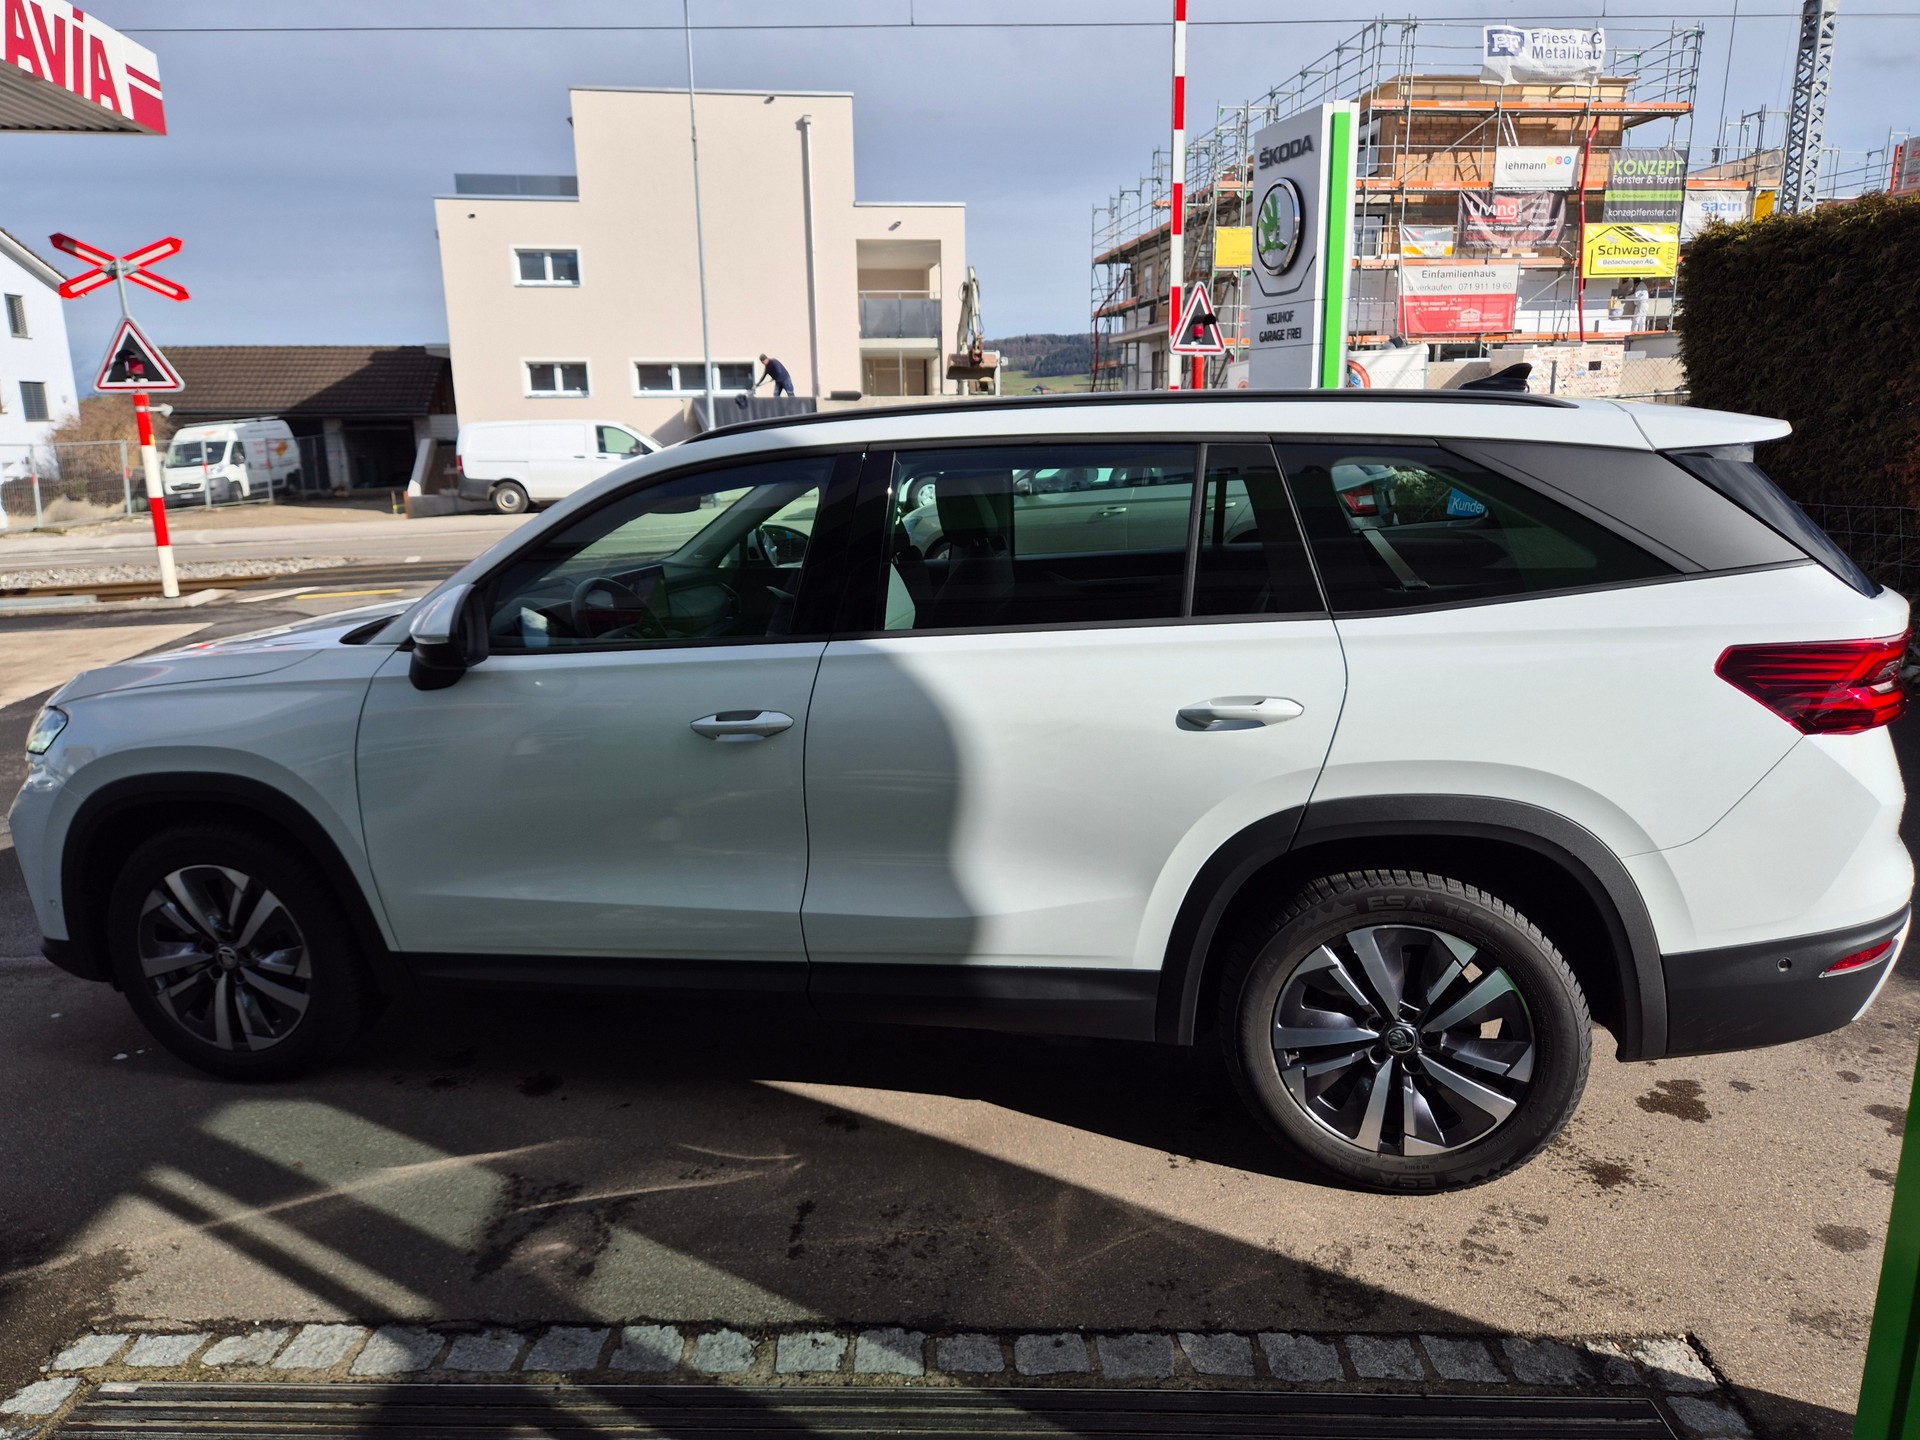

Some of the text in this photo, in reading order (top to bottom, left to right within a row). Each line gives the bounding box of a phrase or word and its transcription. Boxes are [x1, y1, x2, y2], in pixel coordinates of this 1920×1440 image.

[1531, 31, 1602, 45] Friess AG
[1532, 45, 1602, 60] Metallbau
[1259, 134, 1314, 170] ŠKODA
[1505, 160, 1547, 171] lehmann
[1613, 159, 1682, 176] KONZEPT
[1612, 174, 1680, 184] Fenster & Türen
[1470, 201, 1517, 220] Living
[1608, 207, 1677, 218] konzeptfenster.ch
[1598, 245, 1661, 257] Schwager
[1602, 258, 1643, 266] Bedachungen
[1421, 269, 1496, 279] Einfamilienhaus
[1458, 282, 1472, 291] 071
[1475, 282, 1488, 290] 911
[1492, 281, 1500, 290] 19
[1502, 281, 1512, 290] 60
[1266, 310, 1294, 325] NEUHOF
[1259, 327, 1302, 343] GARAGE FREI
